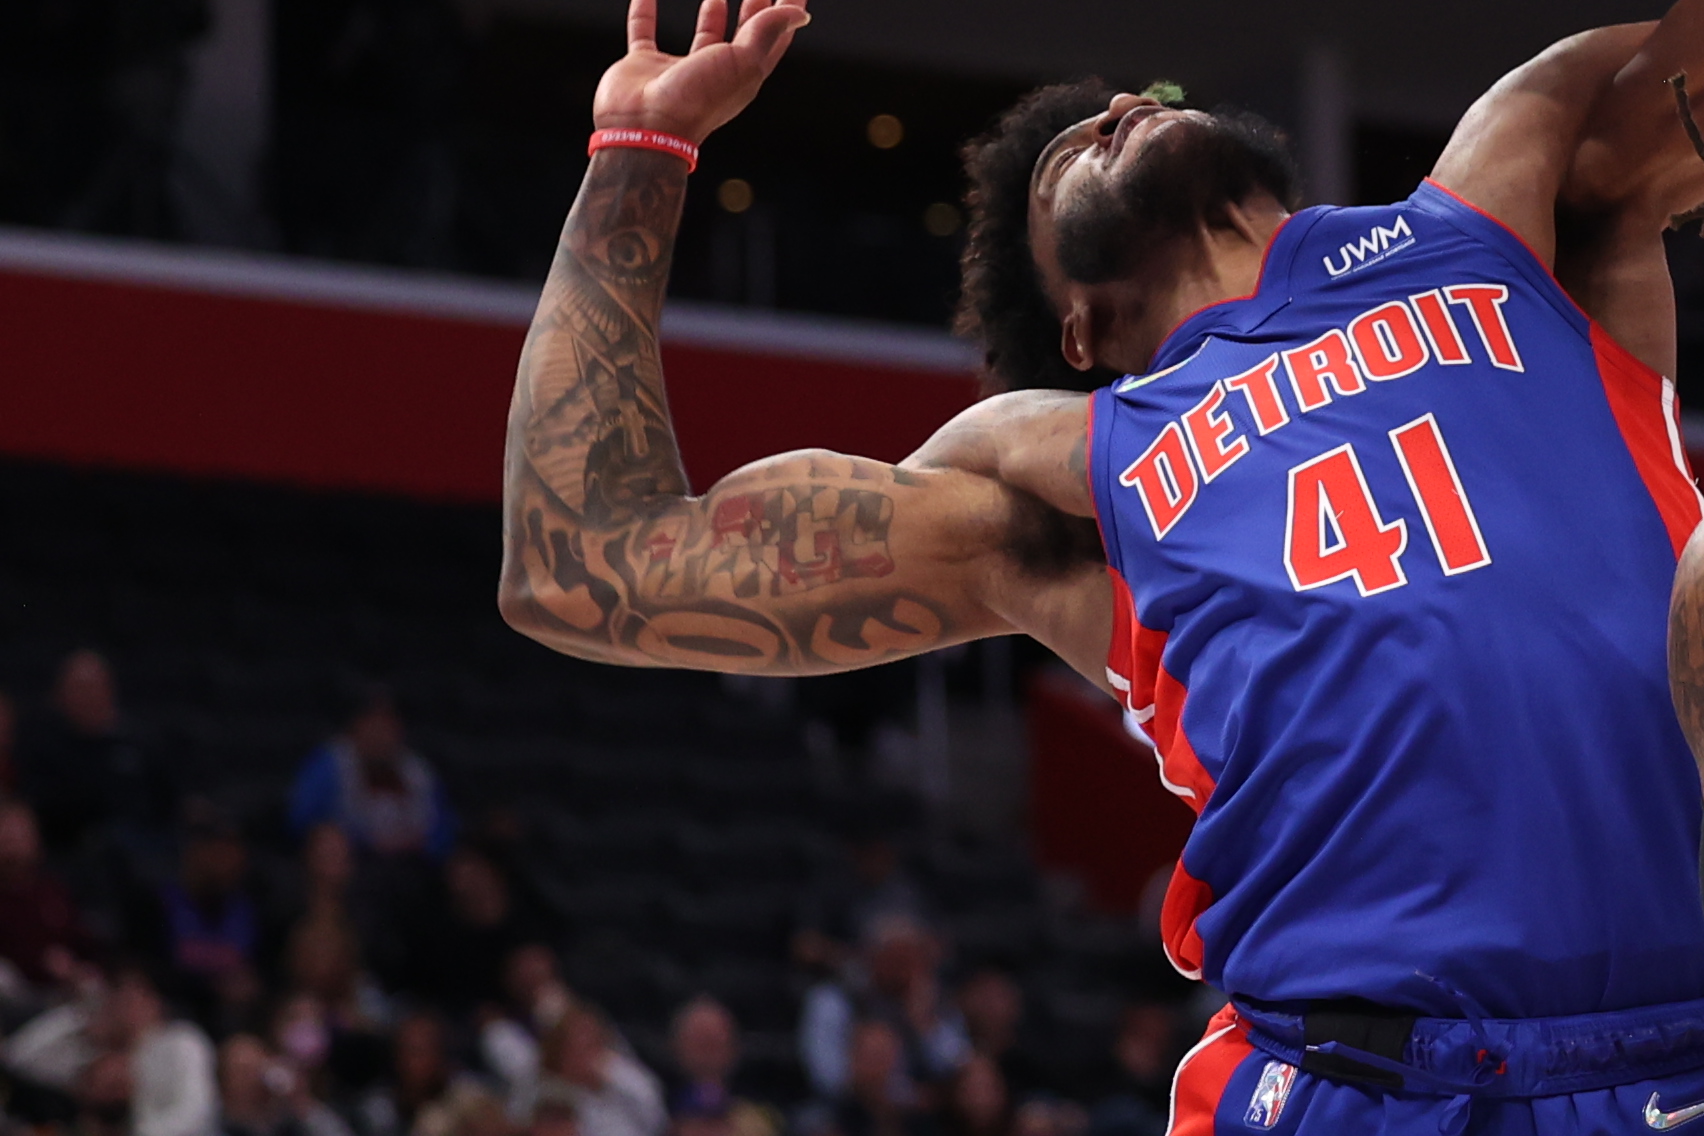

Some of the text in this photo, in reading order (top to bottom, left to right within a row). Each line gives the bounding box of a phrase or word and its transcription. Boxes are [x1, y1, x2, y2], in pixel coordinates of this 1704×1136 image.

[1322, 214, 1413, 276] UWM
[1119, 283, 1524, 541] DETROIT
[1284, 412, 1492, 597] 41
